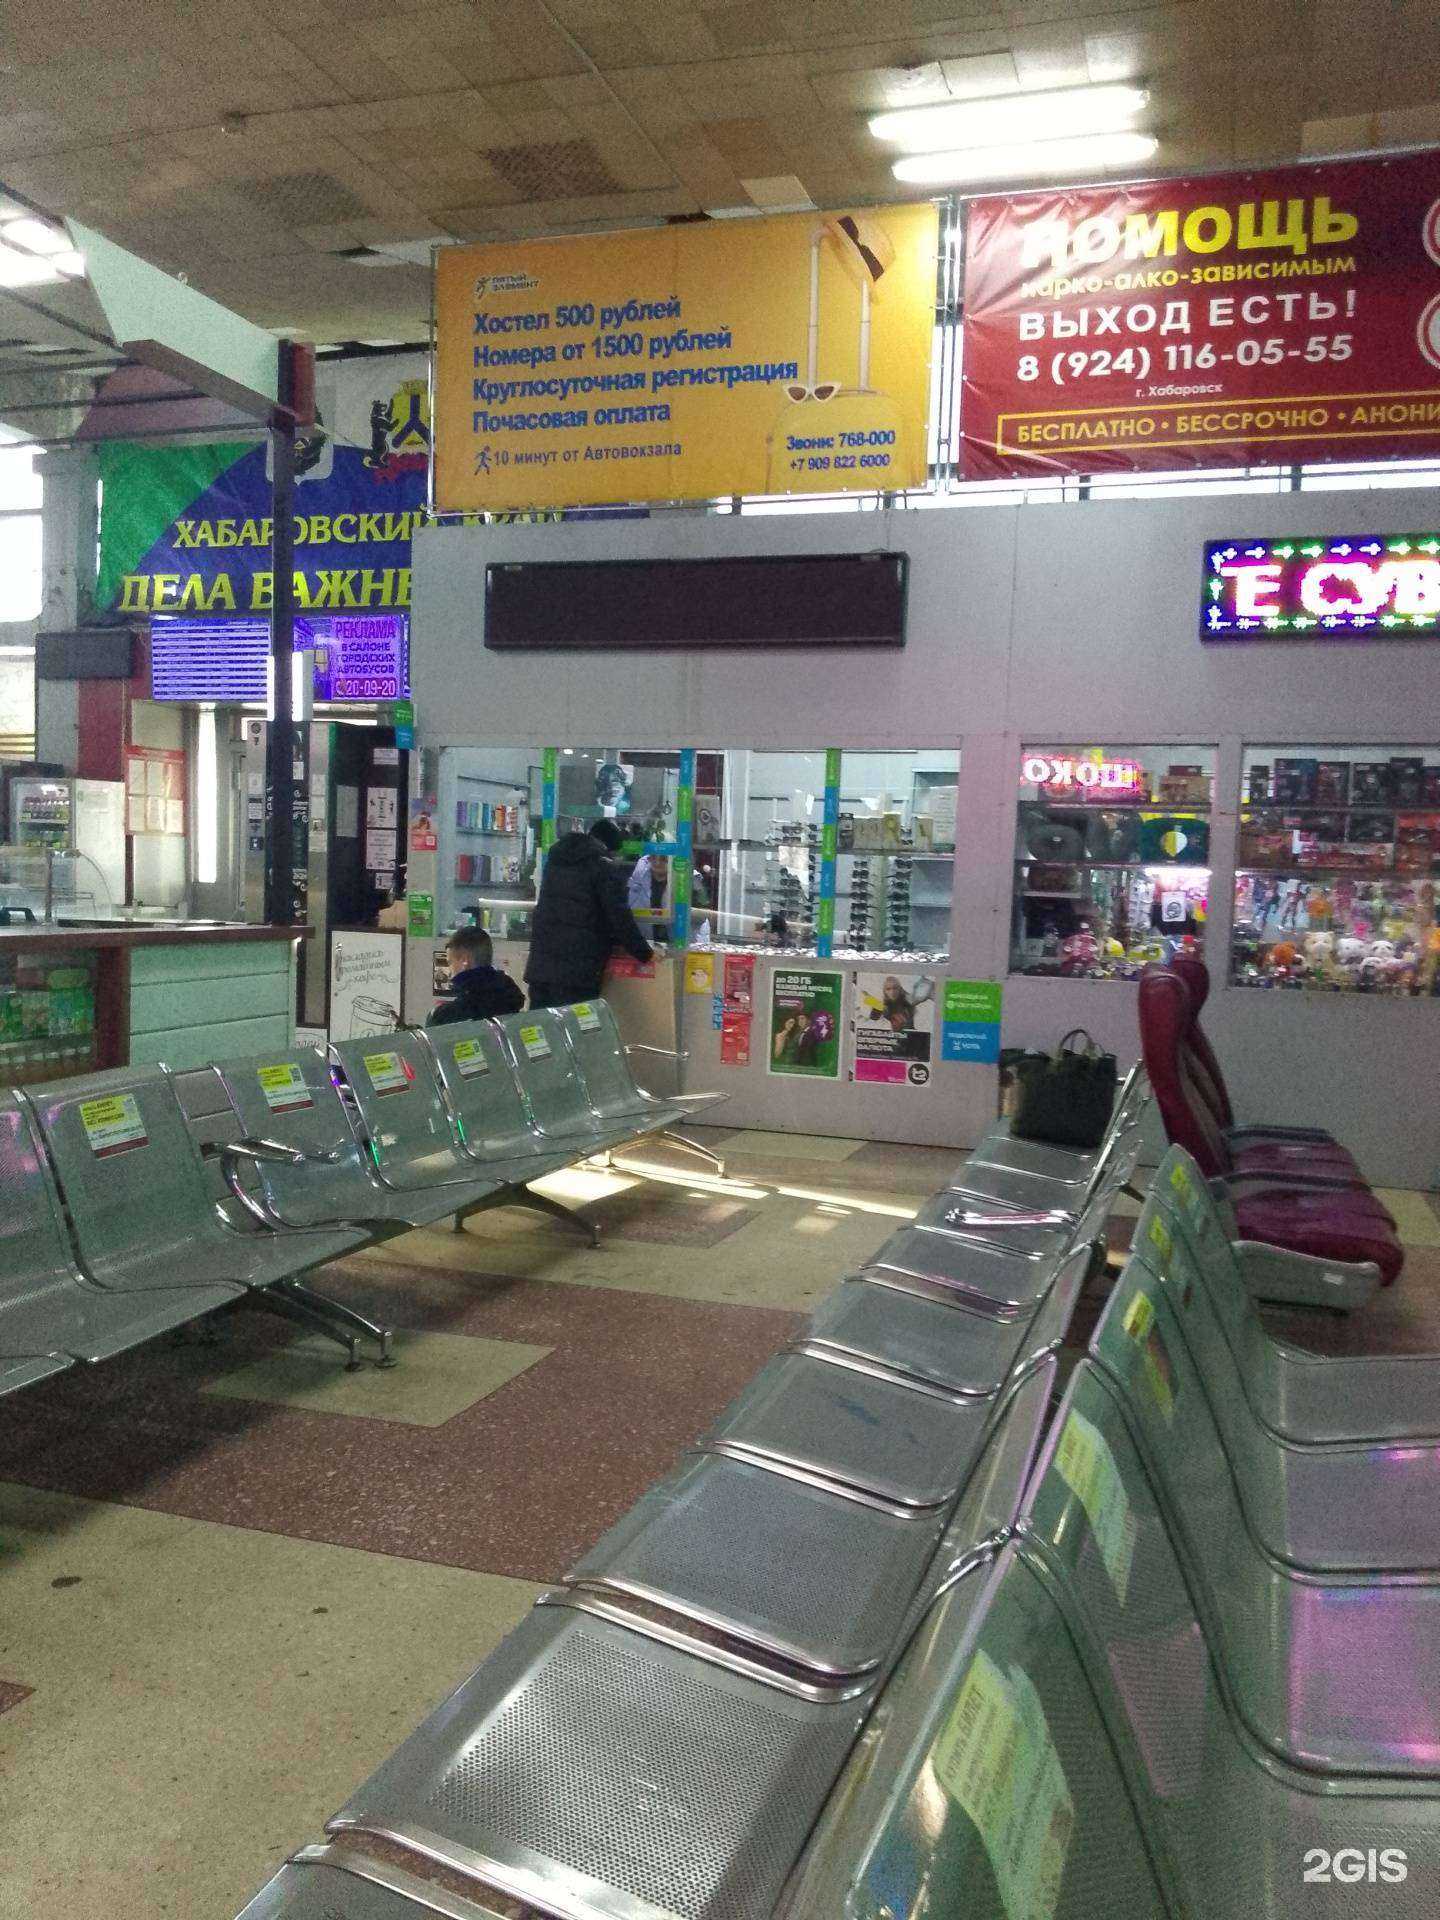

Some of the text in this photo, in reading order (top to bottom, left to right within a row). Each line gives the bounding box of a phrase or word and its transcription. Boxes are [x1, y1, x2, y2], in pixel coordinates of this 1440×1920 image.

[1021, 196, 1359, 270] ПОМОЩЬ
[473, 296, 681, 335] Хостел 500 рублей
[1019, 289, 1356, 341] ВЫХОД ЕСТЬ!
[473, 326, 732, 368] Номера от 1500 рублей
[1017, 333, 1353, 385] 8 (924) 116-05-55
[473, 362, 798, 405] Круглосуточная регистрация
[1149, 382, 1223, 397] Хабаровск
[473, 403, 671, 433] Почасовая оплата
[1017, 417, 1155, 444] БЕСПЛАТНО
[1176, 408, 1329, 434] БЕССРОЧНО
[494, 442, 682, 467] 10 минут от Автовокзала
[118, 573, 236, 612] ДЕЛА
